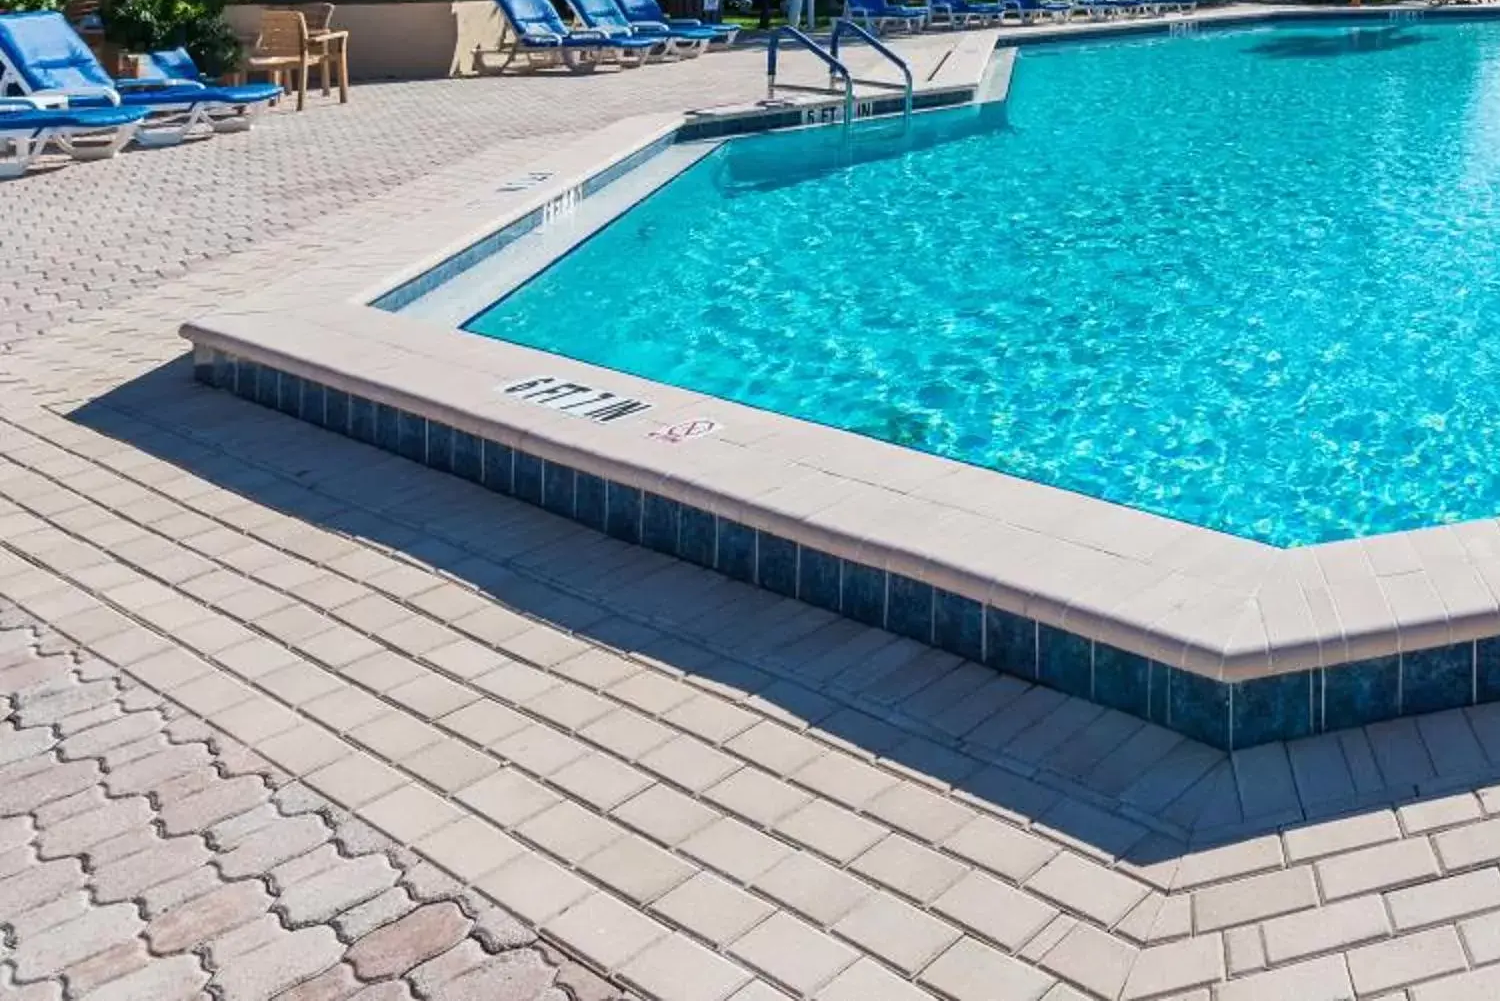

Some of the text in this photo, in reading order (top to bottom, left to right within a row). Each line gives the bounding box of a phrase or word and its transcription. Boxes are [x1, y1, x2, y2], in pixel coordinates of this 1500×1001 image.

[821, 106, 838, 123] FT
[857, 101, 872, 118] IN
[504, 378, 653, 423] 6 FT 7 IN
